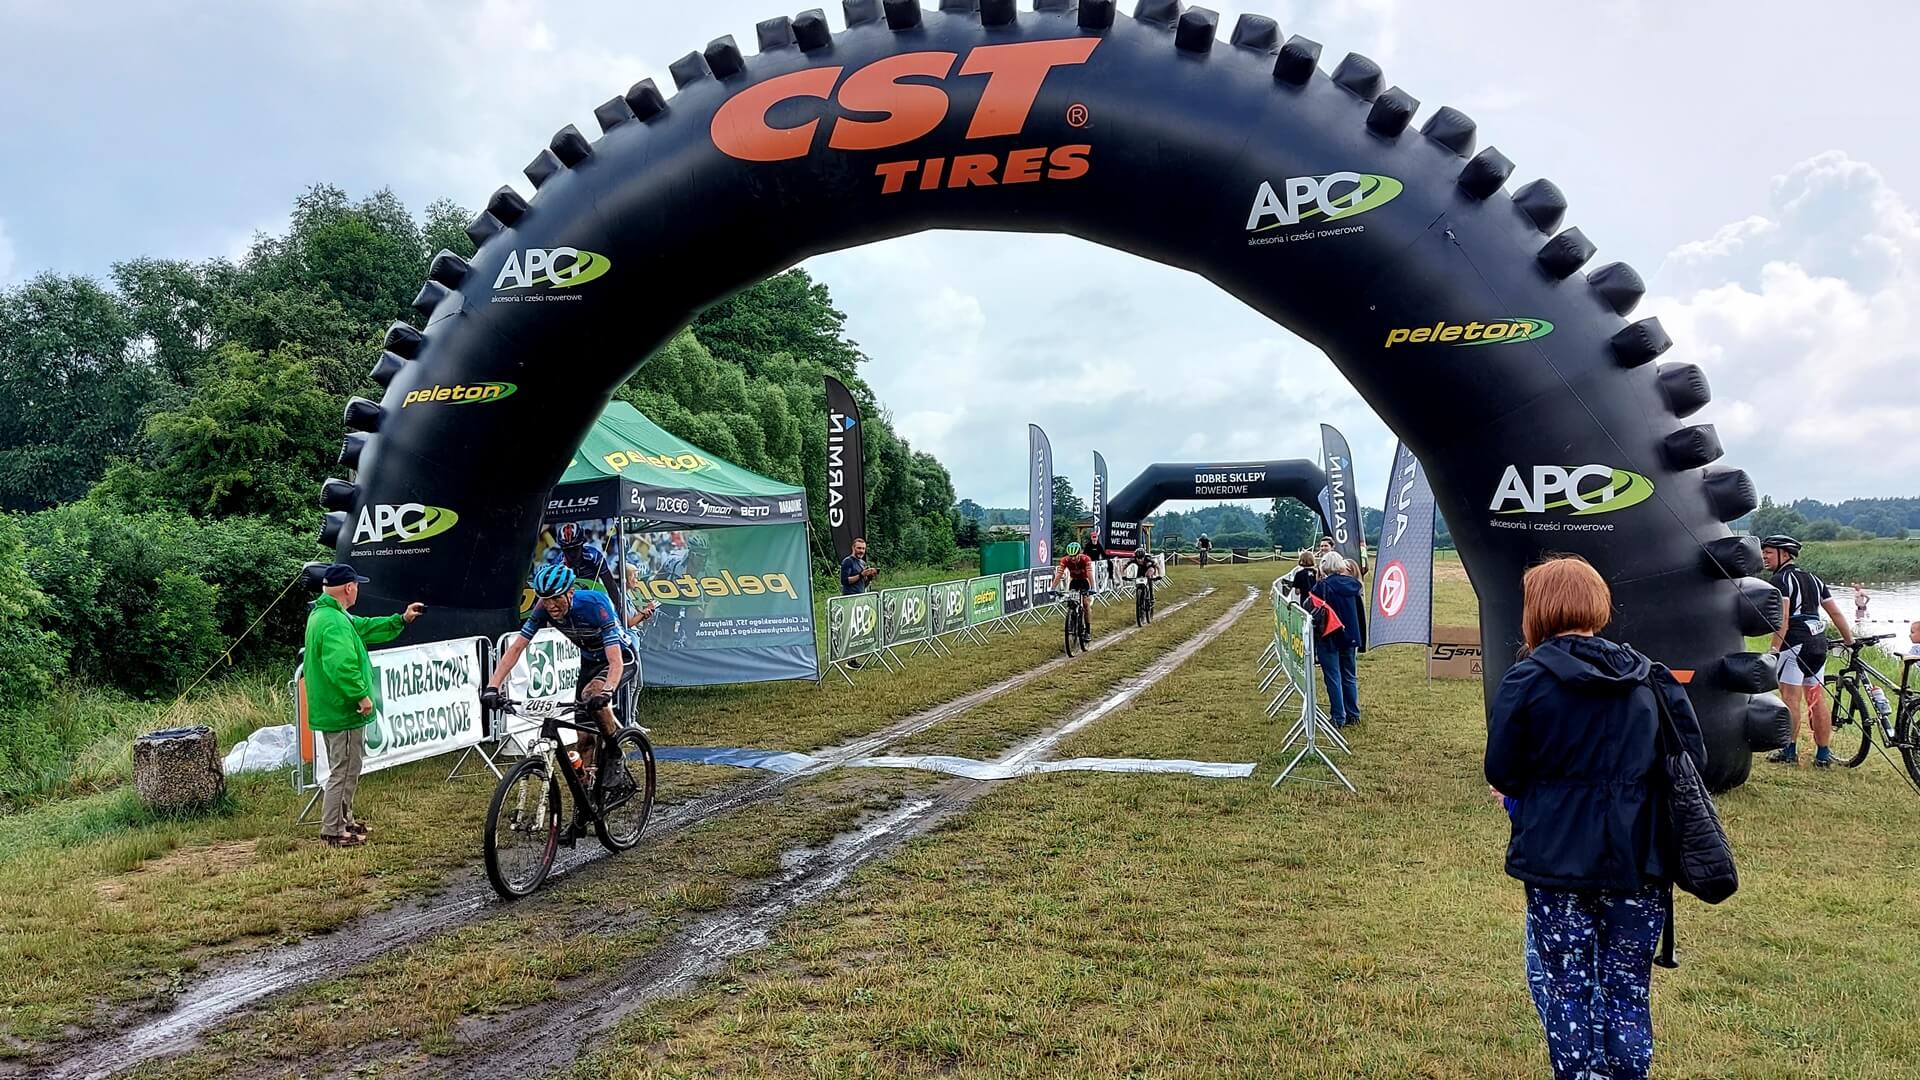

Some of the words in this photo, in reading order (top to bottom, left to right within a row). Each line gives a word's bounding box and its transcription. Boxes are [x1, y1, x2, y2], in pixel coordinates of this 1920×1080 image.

[710, 37, 1103, 161] CST
[875, 144, 1092, 194] TIRES
[1248, 235, 1284, 246] akcesoria
[1290, 229, 1315, 244] części
[1317, 224, 1365, 239] rowerowe
[491, 295, 520, 303] akcesoria
[525, 292, 545, 302] części
[546, 293, 583, 302] rowerowe
[1384, 321, 1534, 348] peleton
[401, 383, 501, 408] peleton
[603, 449, 713, 473] peleton
[1195, 473, 1228, 484] DOBRE
[1229, 471, 1267, 483] SKLEPY
[1195, 485, 1249, 495] ROWEROWE
[740, 506, 771, 517] BETO
[1110, 529, 1130, 537] MAMY
[1111, 521, 1138, 529] ROWERY
[1490, 519, 1527, 530] akcesoria
[1533, 520, 1561, 532] części
[1563, 522, 1615, 532] rowerowe
[395, 547, 431, 555] rowerowe
[1110, 537, 1120, 545] WE
[1121, 538, 1137, 546] KRWI
[1005, 578, 1027, 601] BETO
[556, 640, 580, 663] MARA
[385, 654, 470, 702] MARATONY
[388, 700, 471, 749] KRESOWE
